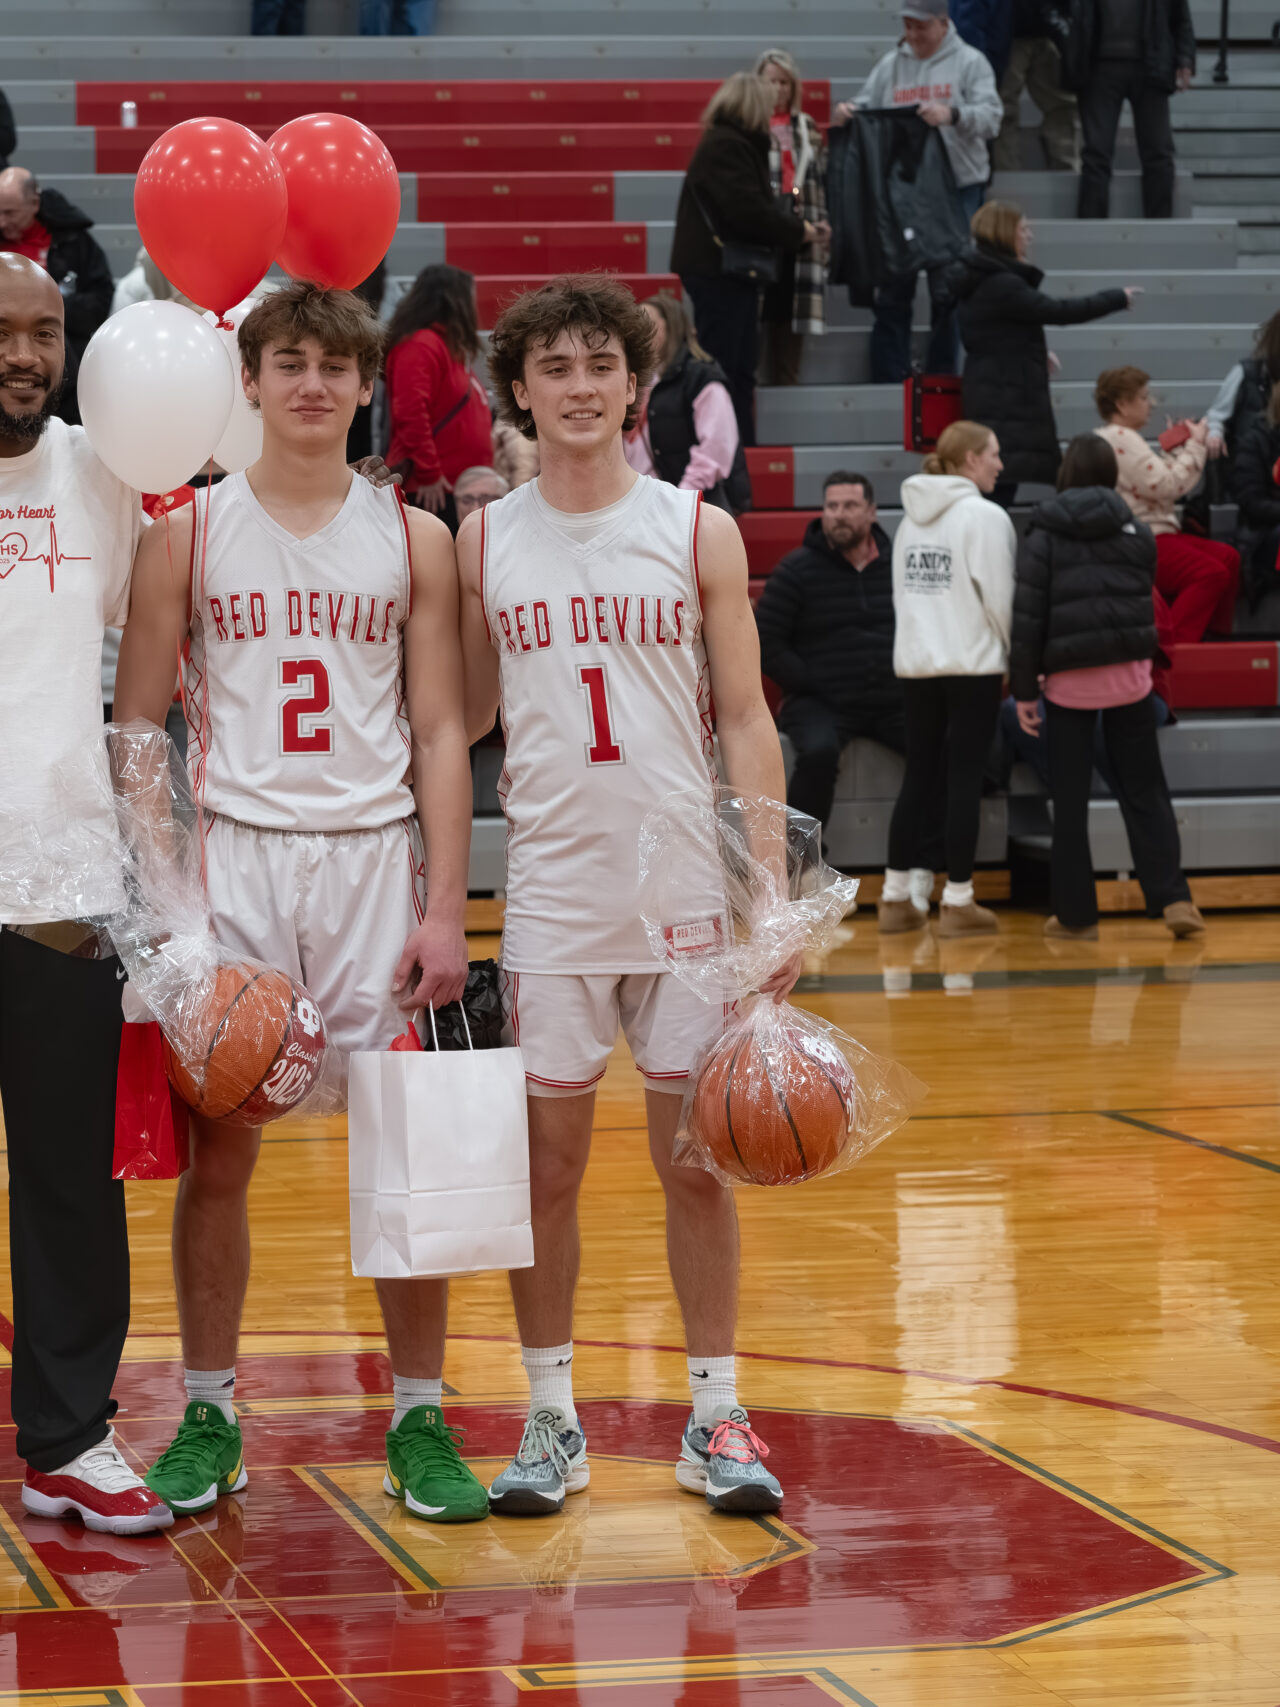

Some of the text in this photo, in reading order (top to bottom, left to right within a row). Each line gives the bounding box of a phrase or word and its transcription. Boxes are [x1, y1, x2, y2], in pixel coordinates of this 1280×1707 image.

[17, 504, 56, 519] Heart
[208, 588, 397, 645] RED DEVILS
[496, 593, 685, 657] RED DEVILS
[277, 655, 335, 757] 2
[575, 662, 626, 768] 1
[262, 1058, 312, 1105] 2025
